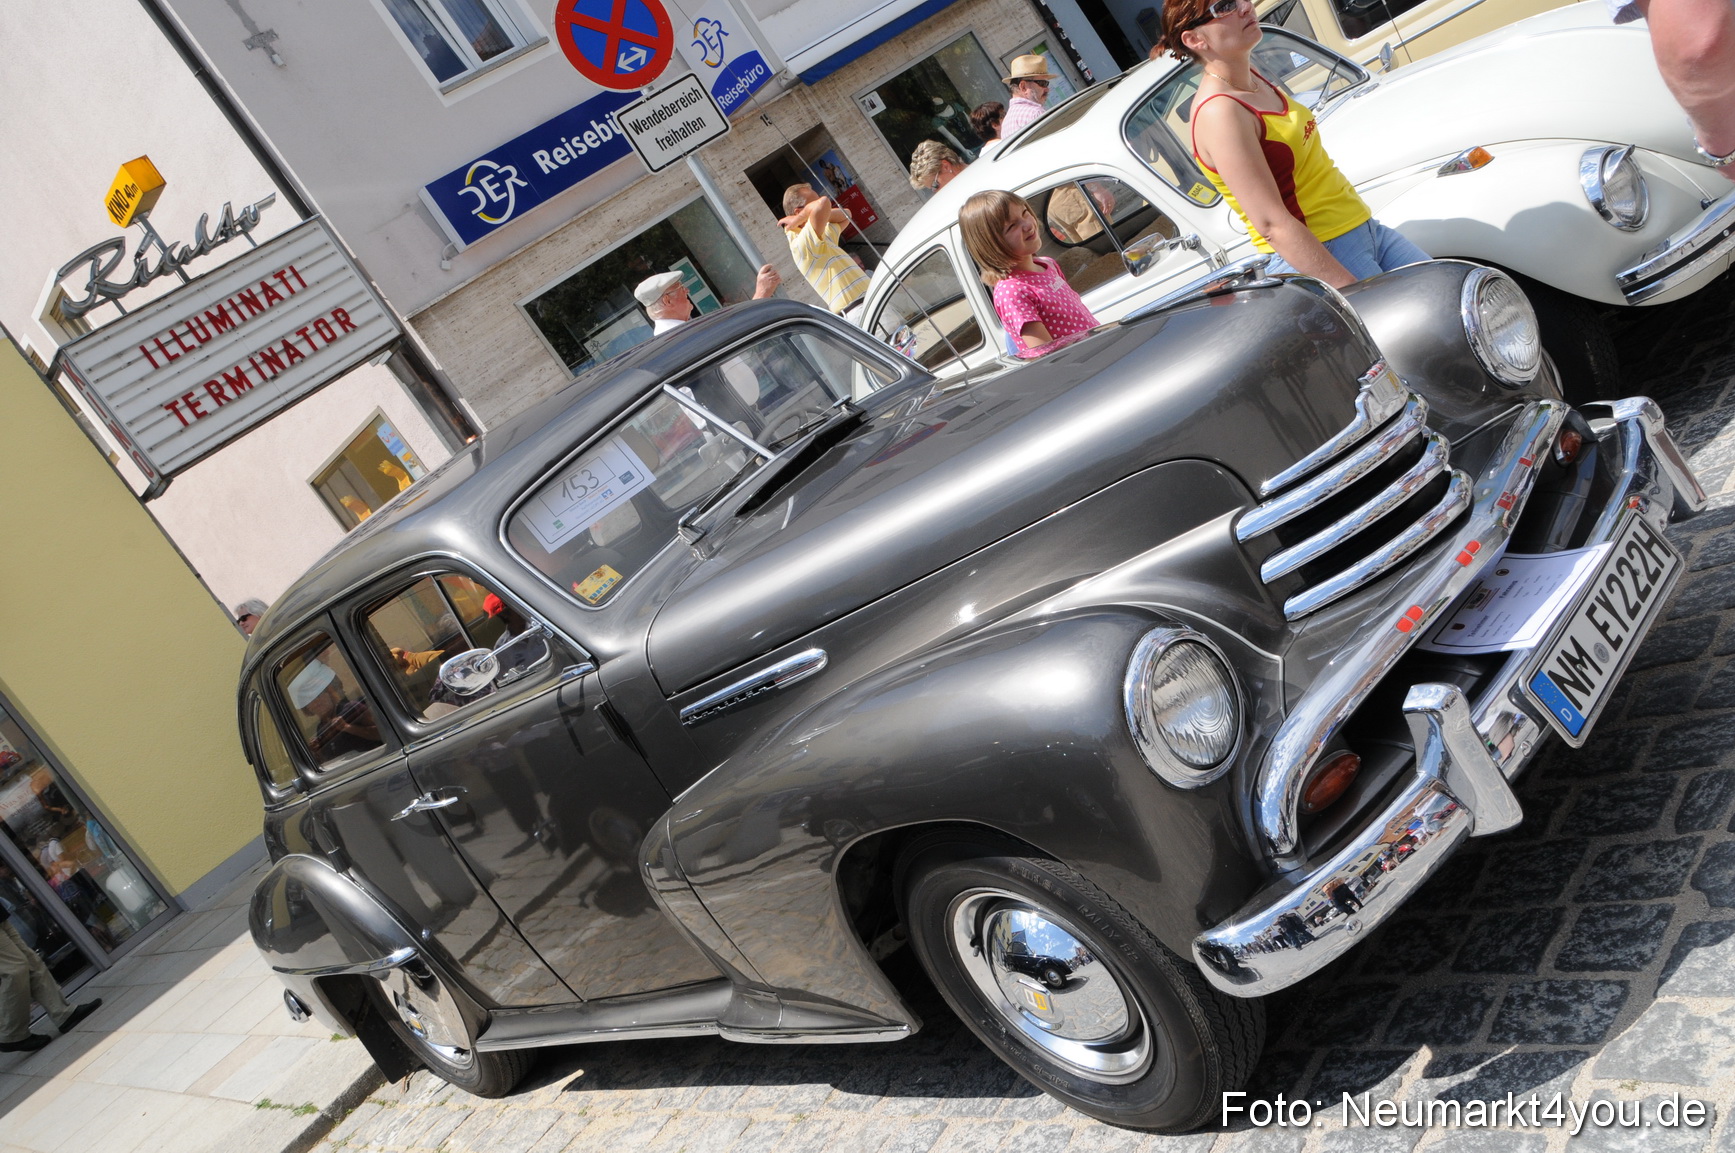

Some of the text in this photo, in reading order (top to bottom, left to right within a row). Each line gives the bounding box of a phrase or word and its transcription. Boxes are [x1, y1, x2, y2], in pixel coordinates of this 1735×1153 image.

[690, 18, 729, 67] DER
[717, 63, 765, 110] Reisebüro
[629, 87, 703, 137] Wendebereich
[655, 115, 706, 153] freihalten
[107, 181, 139, 224] KINO 40m
[457, 161, 528, 221] DER
[59, 192, 276, 320] Rialto
[139, 265, 308, 370] ILLUMINATI
[164, 307, 359, 427] TERMINATOR
[561, 468, 600, 502] 153
[1548, 635, 1603, 711] NM
[1560, 708, 1573, 722] D
